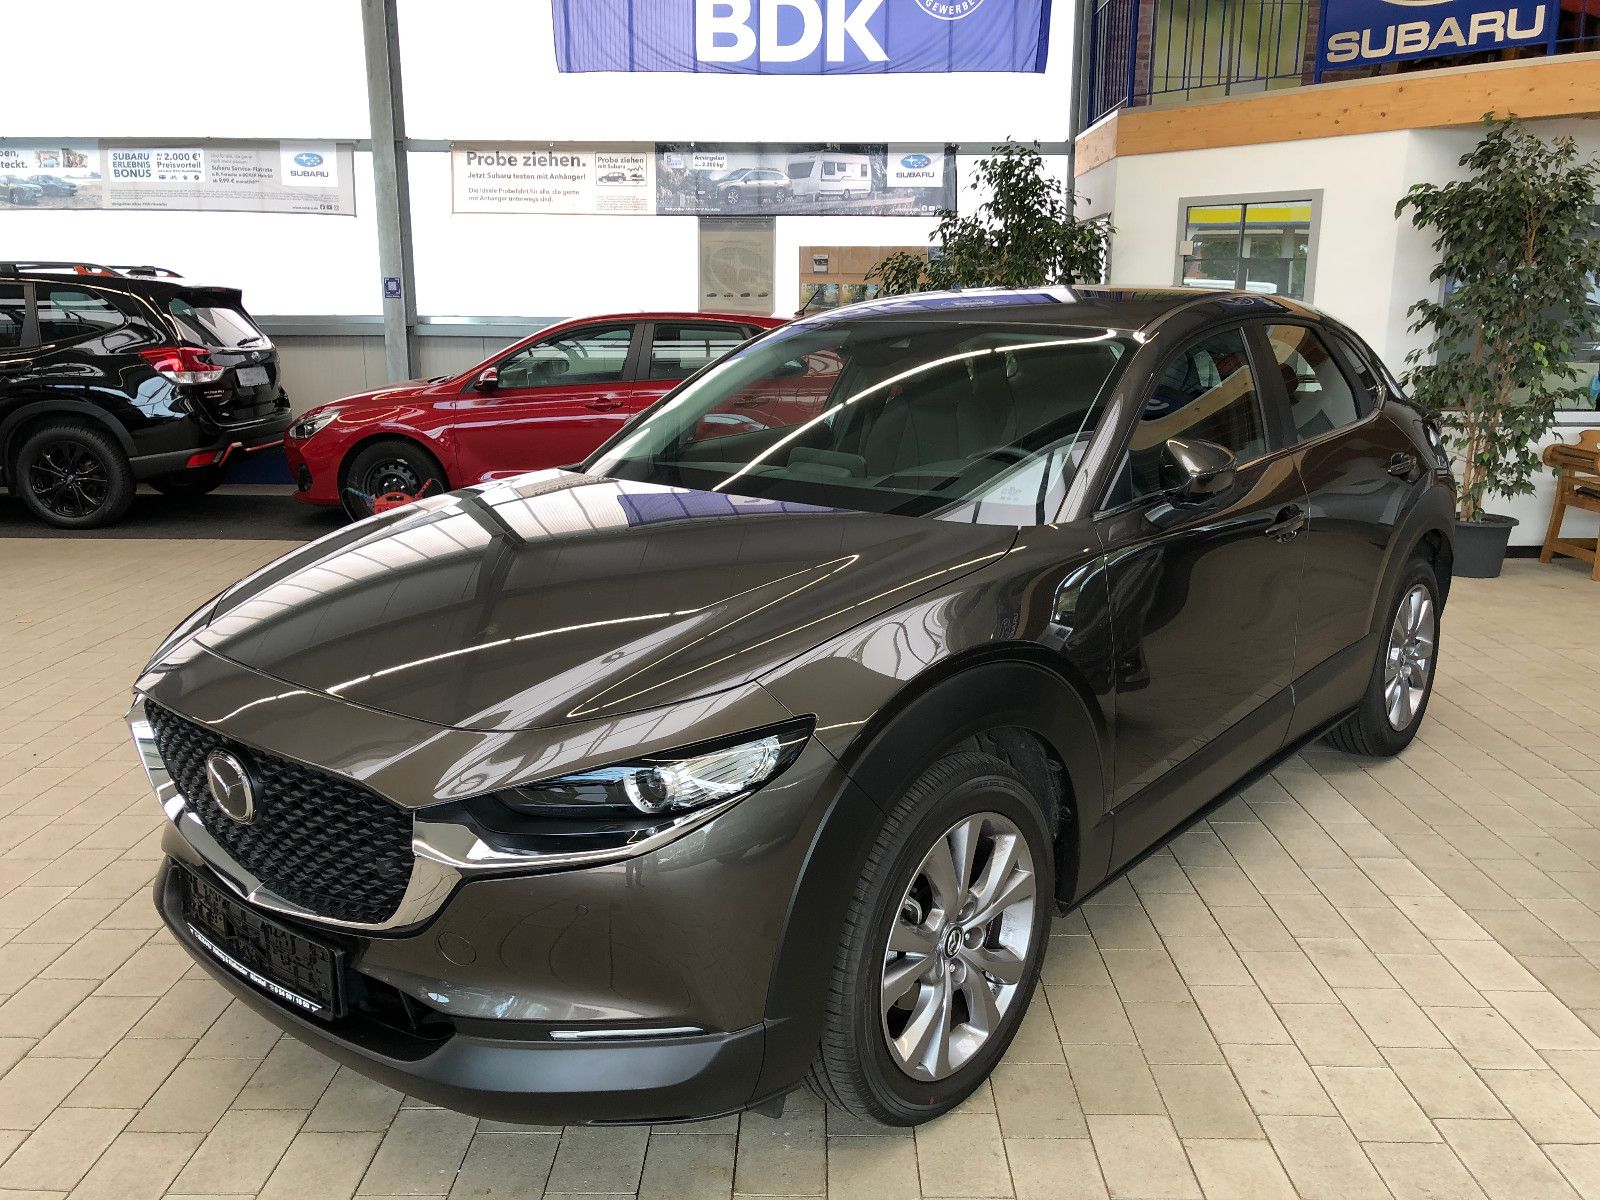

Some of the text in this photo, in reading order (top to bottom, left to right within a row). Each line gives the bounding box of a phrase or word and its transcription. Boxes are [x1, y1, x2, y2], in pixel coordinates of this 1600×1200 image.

[697, 0, 890, 62] BDK
[1326, 5, 1546, 63] SUBARU
[112, 153, 150, 161] SUBARU
[164, 153, 190, 161] 2.000
[466, 151, 587, 167] Probe ziehen.
[597, 156, 644, 164] Probe ziehen
[112, 161, 151, 169] ERLEBNIS
[157, 161, 201, 169] Preisvorteil
[113, 169, 152, 178] BONUS
[290, 170, 329, 178] SUBARU
[549, 173, 586, 181] Anhänger!
